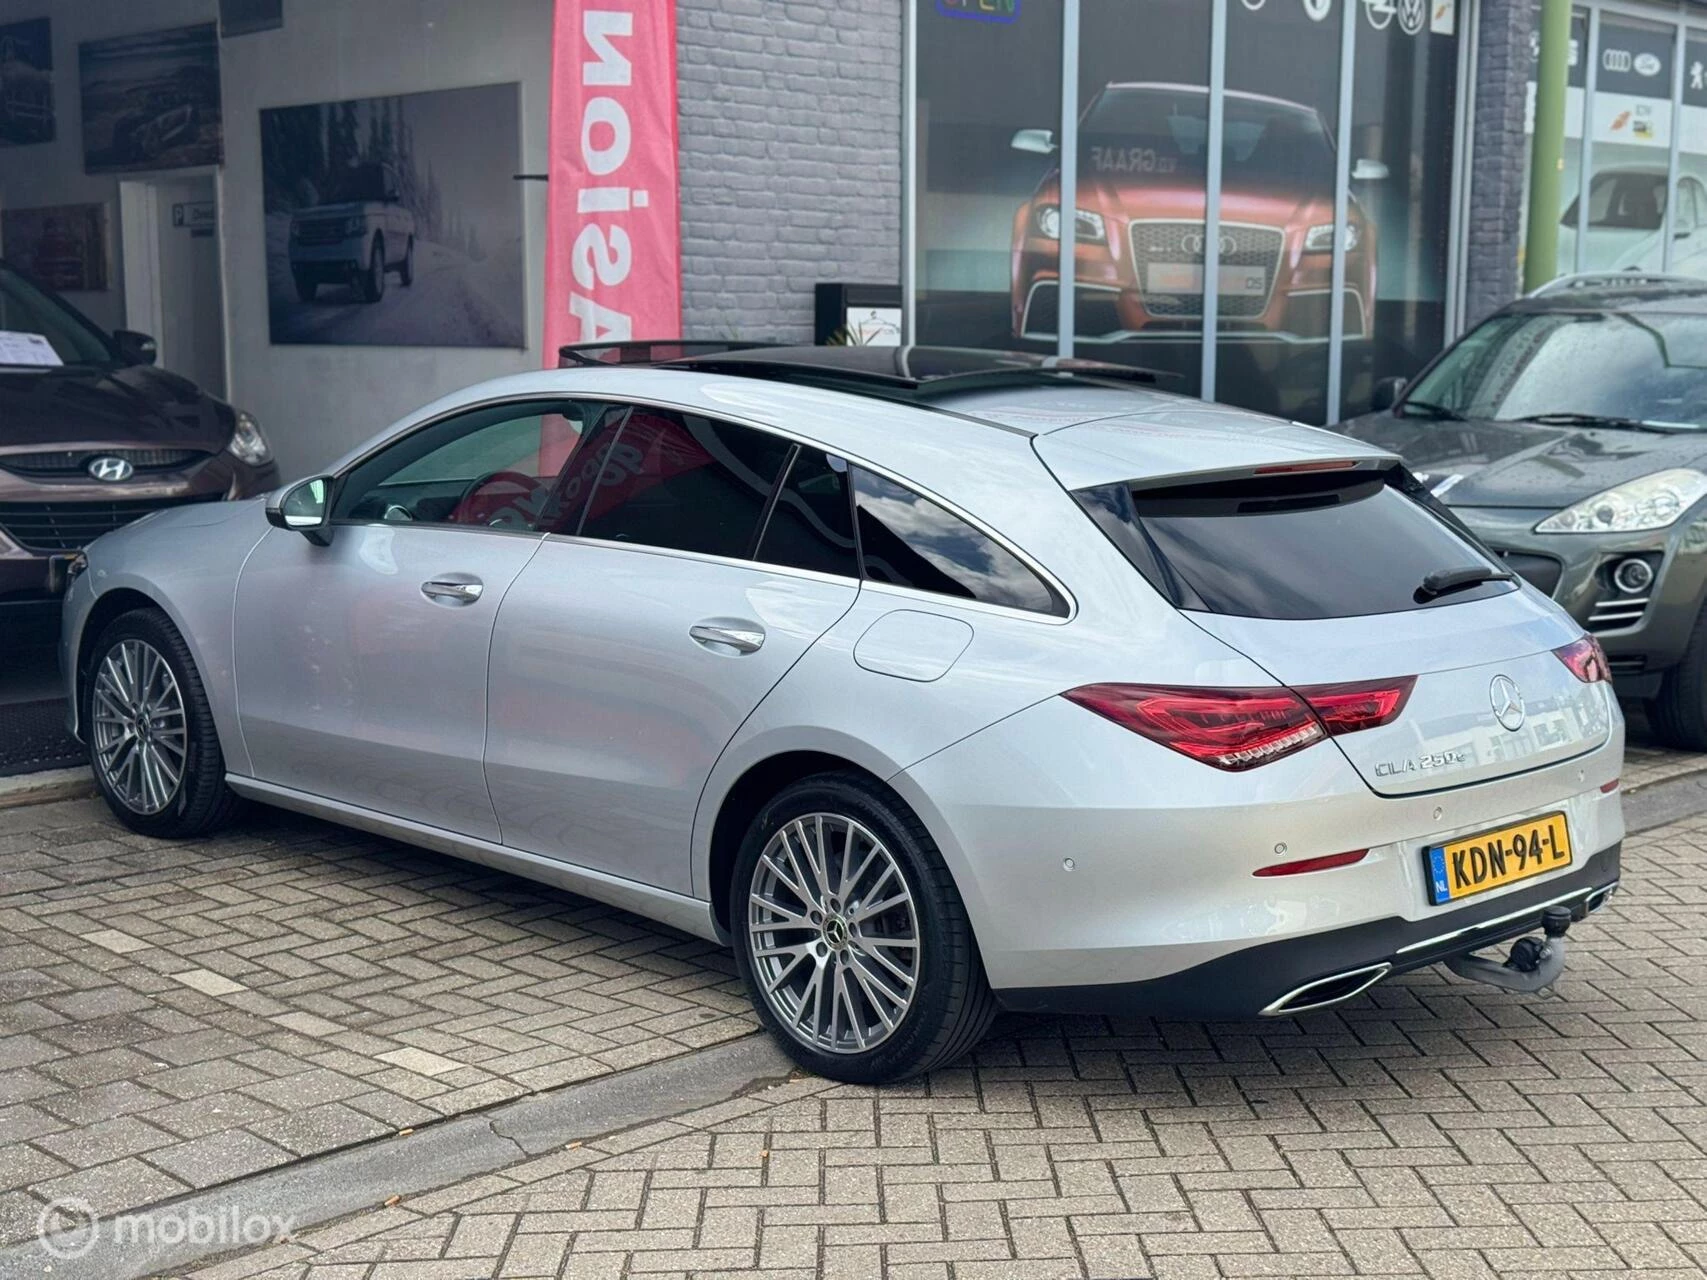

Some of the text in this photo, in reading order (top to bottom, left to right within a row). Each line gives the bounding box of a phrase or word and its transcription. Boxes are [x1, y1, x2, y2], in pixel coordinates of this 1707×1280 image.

[1374, 759, 1416, 777] CLA
[1452, 824, 1565, 889] KDN-94-L
[1435, 880, 1448, 893] NL
